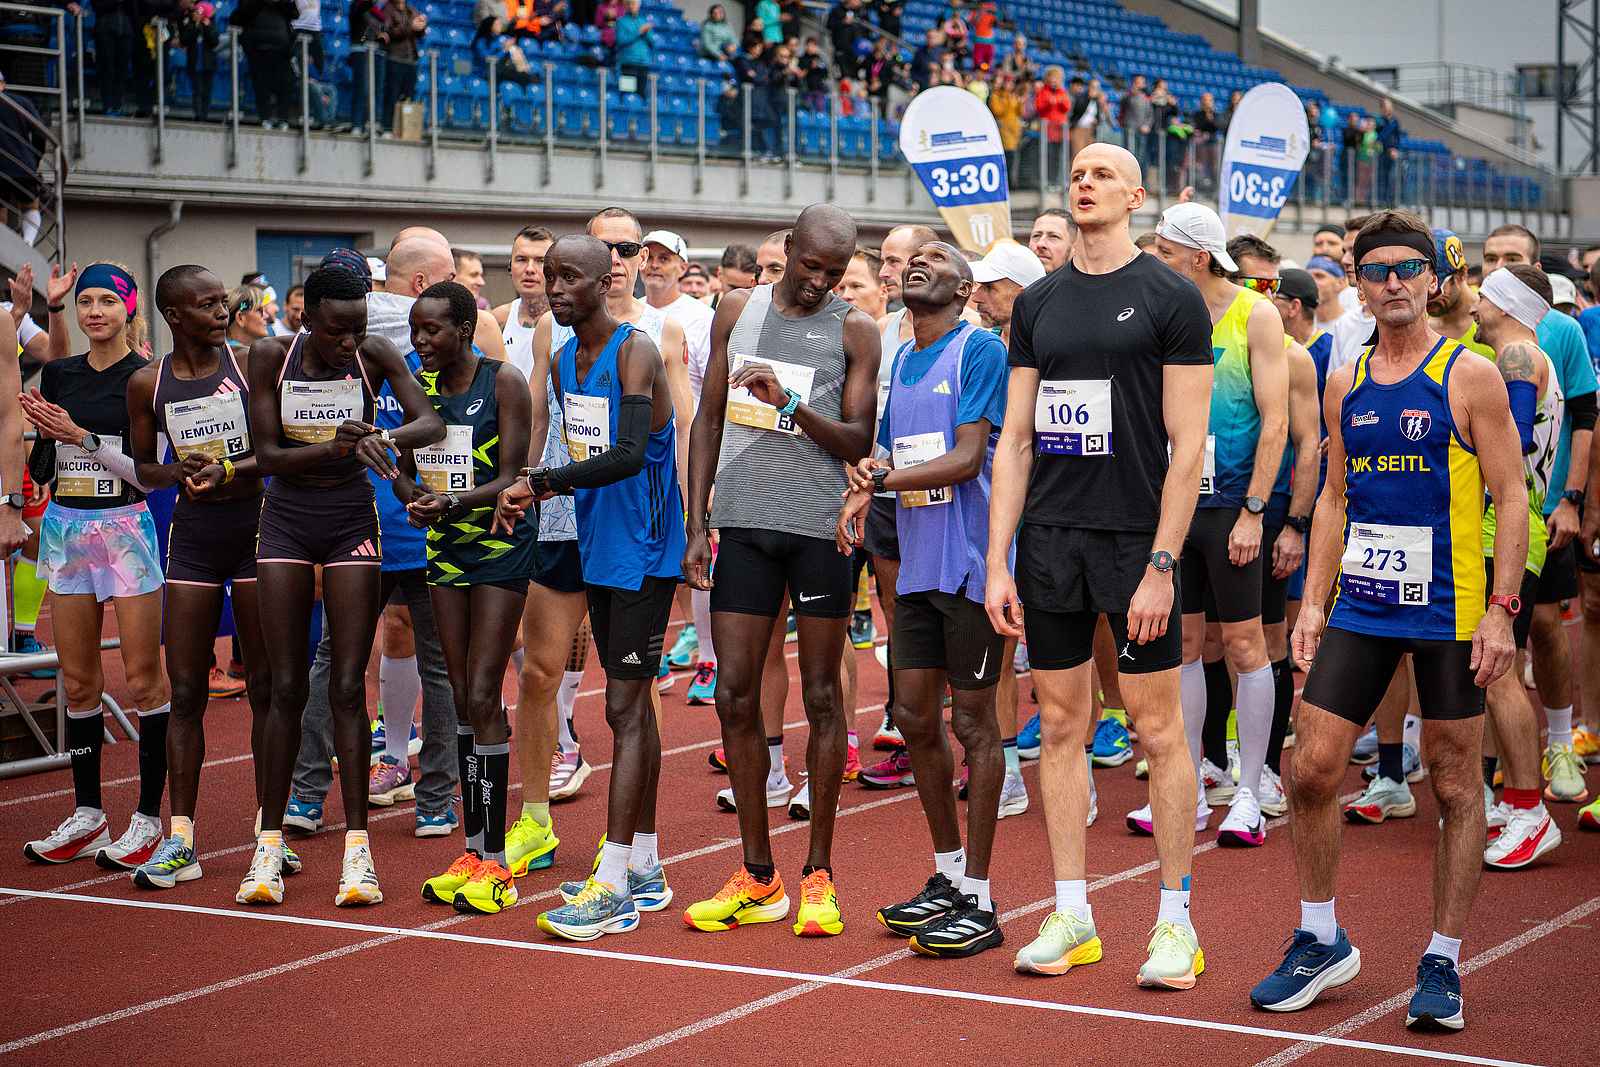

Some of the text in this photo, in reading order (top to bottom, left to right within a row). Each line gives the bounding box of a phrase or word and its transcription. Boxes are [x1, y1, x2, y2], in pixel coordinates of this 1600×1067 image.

[931, 162, 1000, 198] 3:30
[294, 408, 353, 420] JELAGAT
[1048, 403, 1089, 425] 106
[180, 420, 235, 440] JEMUTAI
[416, 453, 469, 465] CHEBURET
[1376, 455, 1431, 472] SEITL
[1361, 547, 1408, 572] 273
